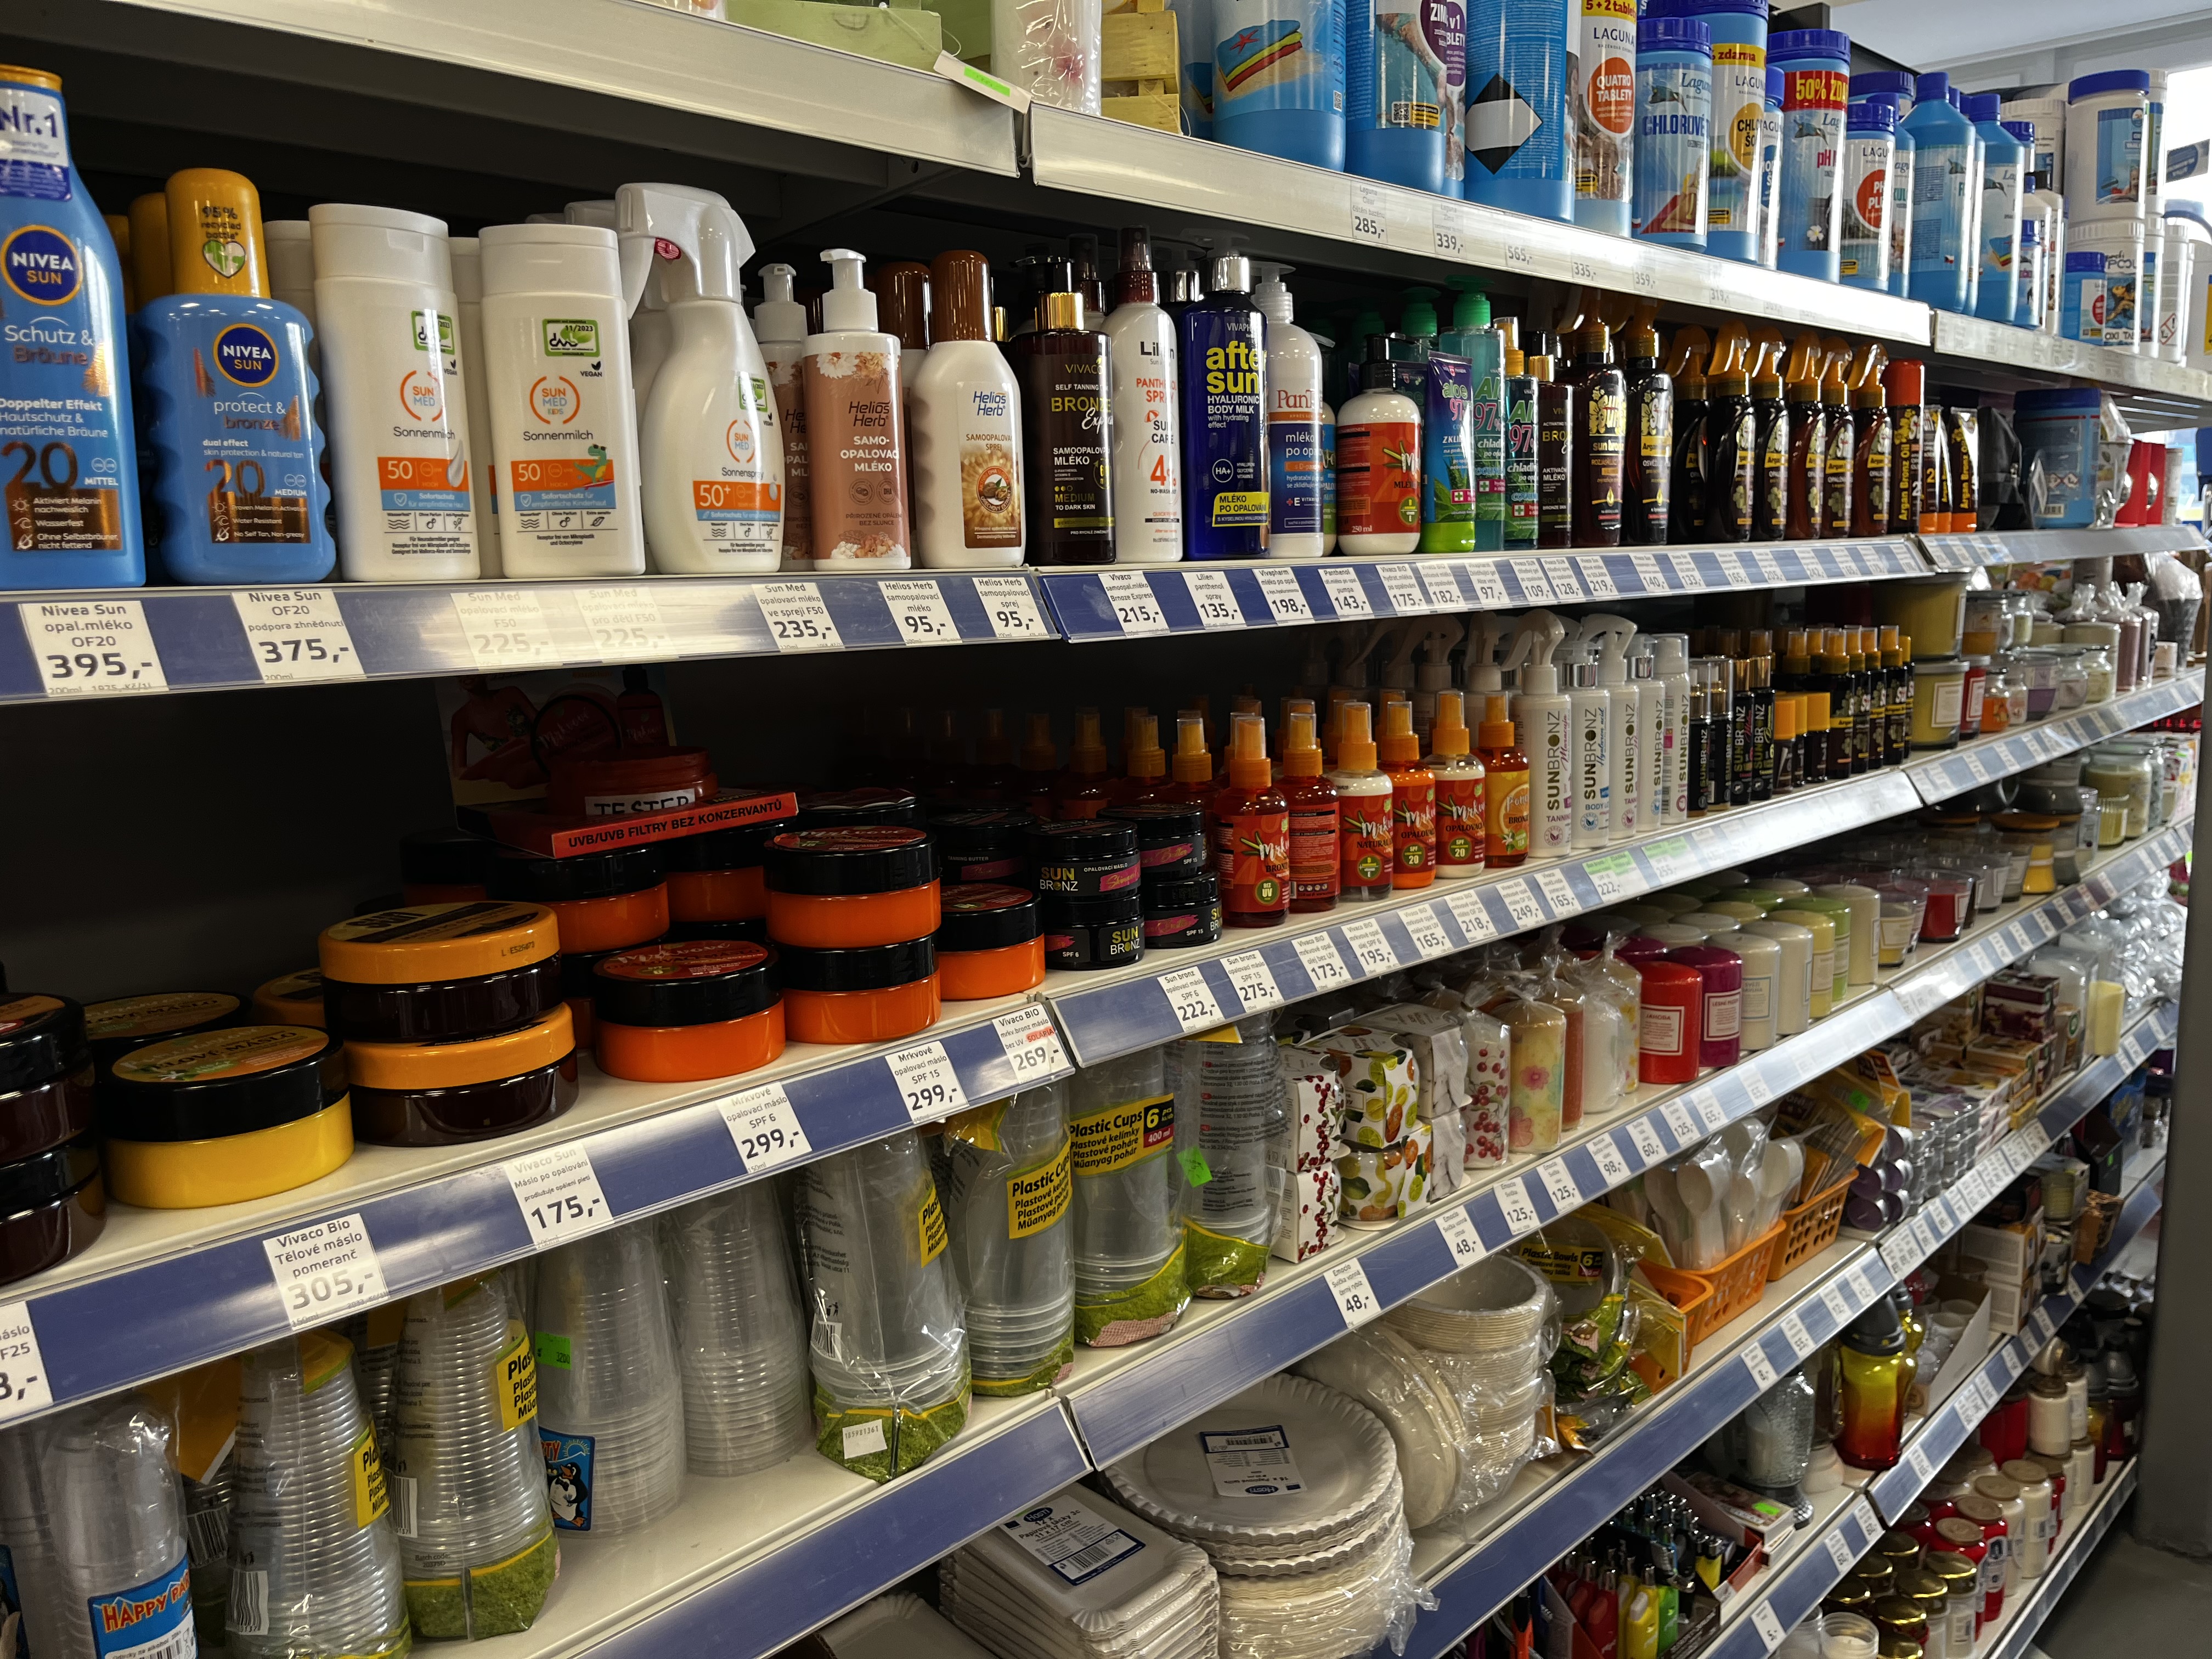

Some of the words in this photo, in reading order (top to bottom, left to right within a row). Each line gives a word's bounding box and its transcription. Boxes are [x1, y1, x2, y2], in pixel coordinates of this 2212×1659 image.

[1594, 27, 1634, 47] LAGUNA
[1718, 48, 1756, 60] zdarma
[1596, 75, 1631, 88] QUATRO
[1596, 89, 1632, 102] TABLETY
[1796, 78, 1827, 100] 50%
[1355, 216, 1385, 239] 285,-
[1436, 233, 1464, 252] 339,-
[11, 251, 74, 271] NIVEA
[27, 270, 62, 285] SUN
[1573, 262, 1596, 279] 335,-
[5, 324, 76, 345] Schutz
[223, 345, 271, 359] NIVEA
[234, 359, 262, 370] SUN
[1065, 364, 1103, 375] VIVACO
[1207, 371, 1259, 394] sun
[413, 386, 434, 396] SUN
[542, 388, 566, 397] SUN
[973, 391, 1006, 404] Helios
[65, 399, 102, 411] Effekt
[214, 399, 273, 415] protect
[414, 397, 435, 407] MED
[543, 398, 567, 407] MED
[848, 400, 890, 414] Helios
[1207, 396, 1260, 404] HYALURONIC
[1208, 405, 1234, 414] BODY
[1236, 405, 1254, 414] MILK
[224, 415, 279, 430] bronze
[1223, 414, 1249, 422] hydrating
[68, 426, 108, 438] Bräune
[523, 430, 594, 442] Sonnenmilch
[735, 433, 748, 442] SUN
[735, 442, 749, 450] MED
[853, 436, 889, 445] SAMO-
[986, 443, 1002, 452] SPREJ
[224, 449, 260, 458] protection
[1900, 444, 1910, 458] Oil
[855, 462, 892, 472] MLÉKO
[1054, 455, 1090, 466] MLÉKO
[518, 464, 540, 481] 50
[1900, 460, 1909, 488] Bronz
[84, 476, 118, 486] MITTEL
[1055, 493, 1095, 503] MEDIUM
[1220, 494, 1246, 503] MLÉKO
[1899, 491, 1910, 521] Argan
[765, 584, 786, 593] Sun
[789, 583, 806, 591] Med
[884, 582, 911, 590] Helios
[1195, 583, 1224, 591] panthenol
[1555, 583, 1580, 596] 128,-
[1589, 580, 1613, 593] 219,-
[1643, 576, 1666, 589] 140,-
[249, 591, 290, 602] Nivea
[295, 590, 321, 601] Sun
[887, 592, 939, 601] samoopalovací
[980, 589, 1030, 599] samoopalovací
[1131, 592, 1153, 601] Express
[1432, 590, 1460, 604] 182,-
[1481, 586, 1503, 601] 97,-
[1525, 585, 1550, 598] 109,-
[1001, 600, 1019, 610] sprej
[1272, 599, 1306, 614] 198,-
[1335, 595, 1367, 611] 143,-
[1393, 592, 1423, 608] 175,-
[41, 605, 89, 616] Nivea
[95, 605, 126, 616] Sun
[272, 605, 309, 616] OF20
[907, 604, 932, 612] mléko
[1119, 606, 1160, 624] 215,-
[1200, 603, 1238, 619] 135,-
[44, 619, 133, 634] opal.mléko
[249, 623, 291, 633] podpora
[294, 619, 344, 629] zhnědnutí
[494, 619, 516, 628] F50
[996, 611, 1035, 630] 95,-
[72, 635, 116, 647] OF20
[473, 633, 548, 655] 225,-
[258, 639, 349, 663] 375,-
[47, 652, 153, 679] 395,-
[1547, 710, 1560, 811] SUNBRONZ
[1584, 708, 1597, 800] SUNBRONZ
[568, 827, 625, 849] UVB/UVB
[628, 821, 668, 839] FILTRY
[672, 816, 695, 831] BEZ
[697, 798, 783, 825] KONZERVANTŮ
[1454, 848, 1466, 858] 20
[1041, 867, 1075, 880] SUN
[1040, 879, 1078, 892] BRONZ
[1598, 881, 1621, 895] 222,-
[1550, 895, 1575, 909] 165,-
[1513, 905, 1540, 921] 249,-
[1462, 919, 1491, 933] 218,-
[1112, 926, 1138, 944] SUN
[1417, 933, 1445, 949] 165,-
[1360, 948, 1391, 966] 195,-
[1165, 975, 1178, 984] Sun
[1180, 970, 1195, 980] bronz
[1166, 983, 1190, 994] opalovací
[999, 1015, 1024, 1026] Vivaco
[1025, 1008, 1039, 1018] BIO
[1178, 1002, 1216, 1022] 222,-
[1032, 1018, 1049, 1028] máslo
[1027, 1029, 1054, 1042] SOLÁRIA
[898, 1047, 933, 1063] Mrkvové
[1013, 1047, 1059, 1071] 269,-
[894, 1060, 927, 1076] opalovací
[927, 1054, 947, 1066] máslo
[912, 1072, 927, 1085] SPF
[930, 1069, 940, 1079] 15
[749, 1115, 768, 1129] SPF
[1109, 1127, 1139, 1142] kelímky
[1110, 1136, 1138, 1152] poháre
[1114, 1147, 1137, 1163] pohár
[1602, 1161, 1622, 1176] 98,-
[515, 1175, 539, 1189] Máslo
[541, 1171, 550, 1182] po
[1551, 1187, 1576, 1203] 125,-
[531, 1195, 601, 1229] 175,-
[1506, 1207, 1535, 1224] 125,-
[277, 1228, 324, 1248] Vivaco
[327, 1218, 350, 1233] Bio
[324, 1231, 363, 1251] máslo
[1456, 1239, 1476, 1255] 48,-
[1554, 1251, 1578, 1262] Bowls
[1583, 1255, 1593, 1266] 6
[292, 1249, 358, 1279] pomeranč
[1346, 1295, 1369, 1312] 48,-
[101, 1592, 167, 1633] HAPPY
